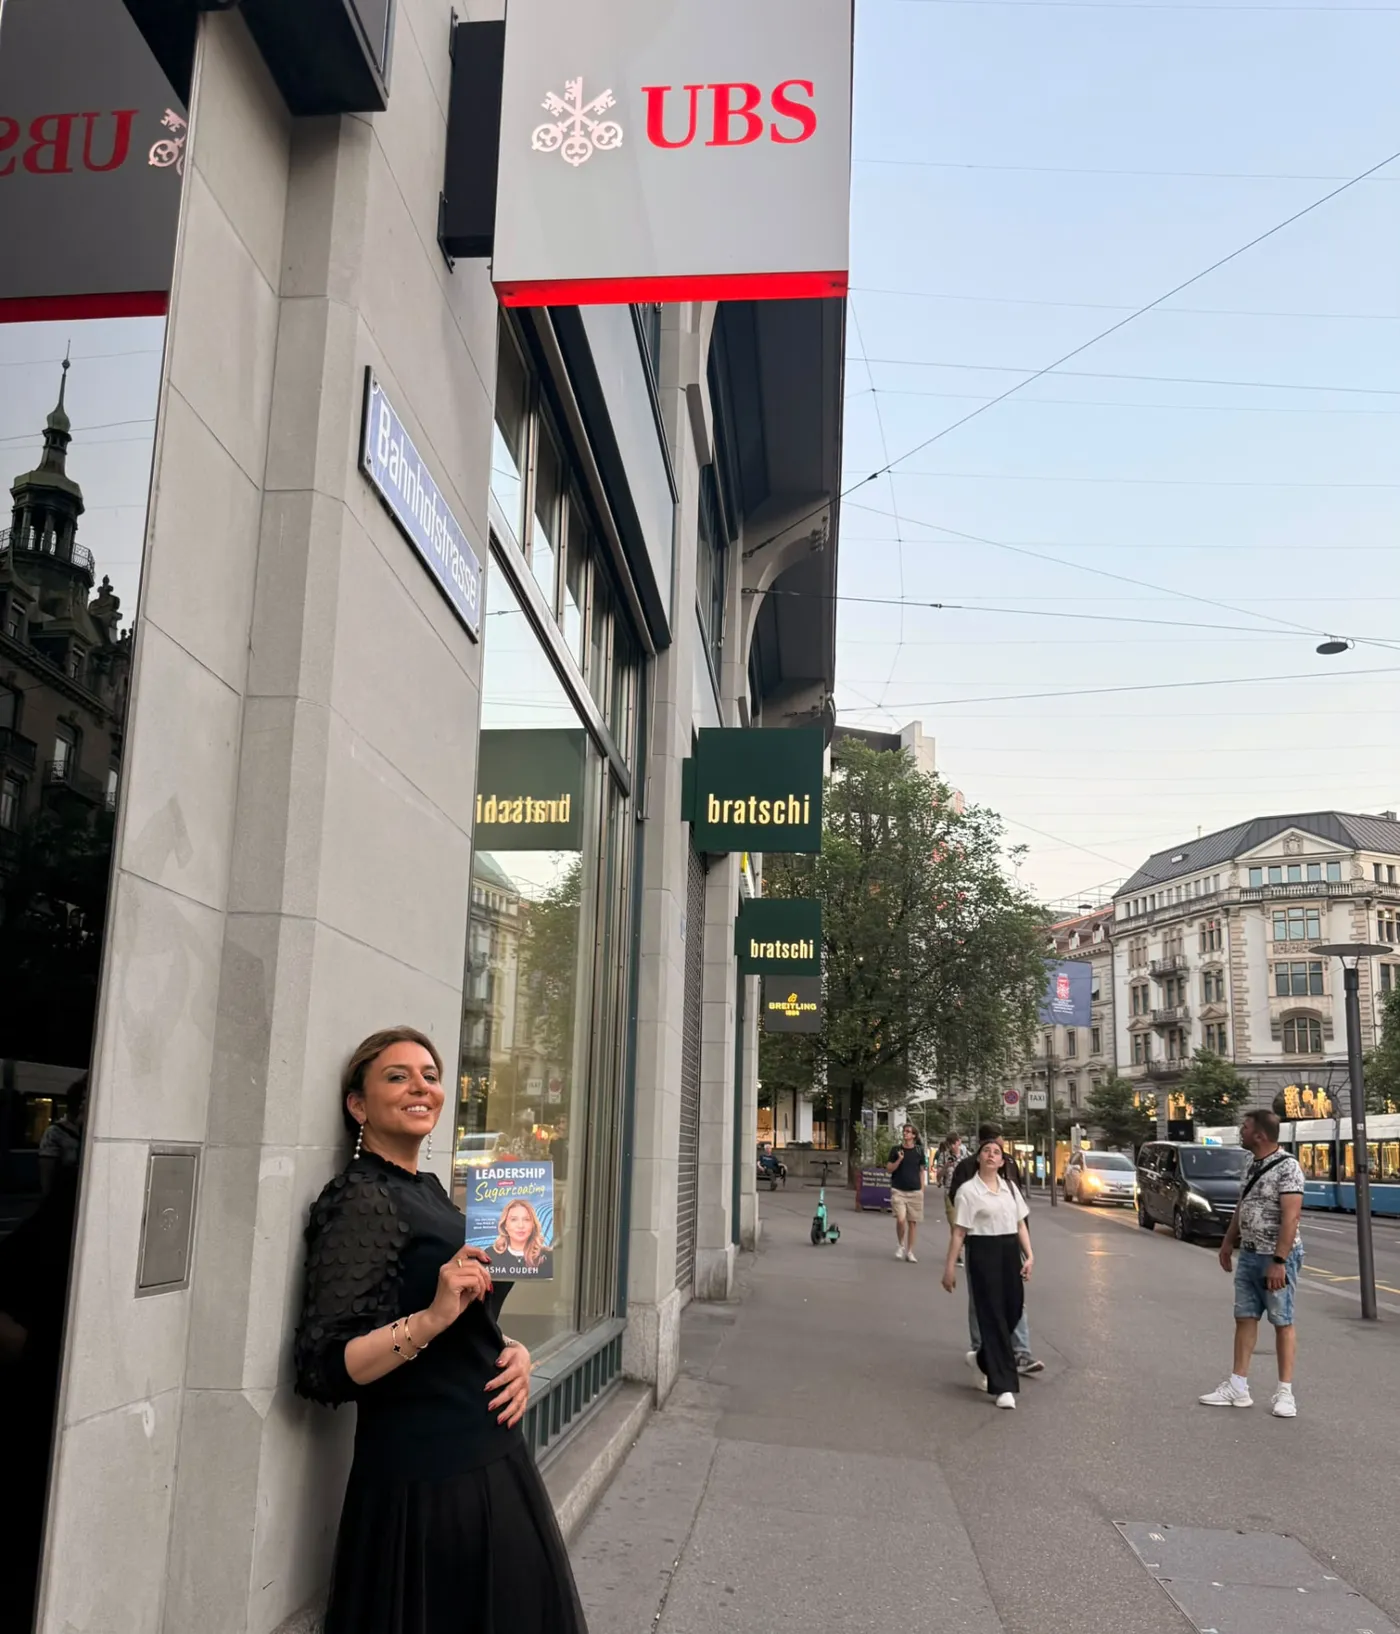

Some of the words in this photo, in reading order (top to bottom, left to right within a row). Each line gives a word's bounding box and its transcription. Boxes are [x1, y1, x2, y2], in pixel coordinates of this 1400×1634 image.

[641, 79, 817, 149] UBS
[377, 399, 476, 611] Bahnhofstrasse
[708, 793, 810, 824] bratschi
[750, 938, 814, 959] bratschi
[768, 1002, 817, 1011] BREITLING
[475, 1167, 546, 1180] LEADERSHIP
[475, 1181, 546, 1203] Sugarcoating
[484, 1266, 507, 1274] ASHA
